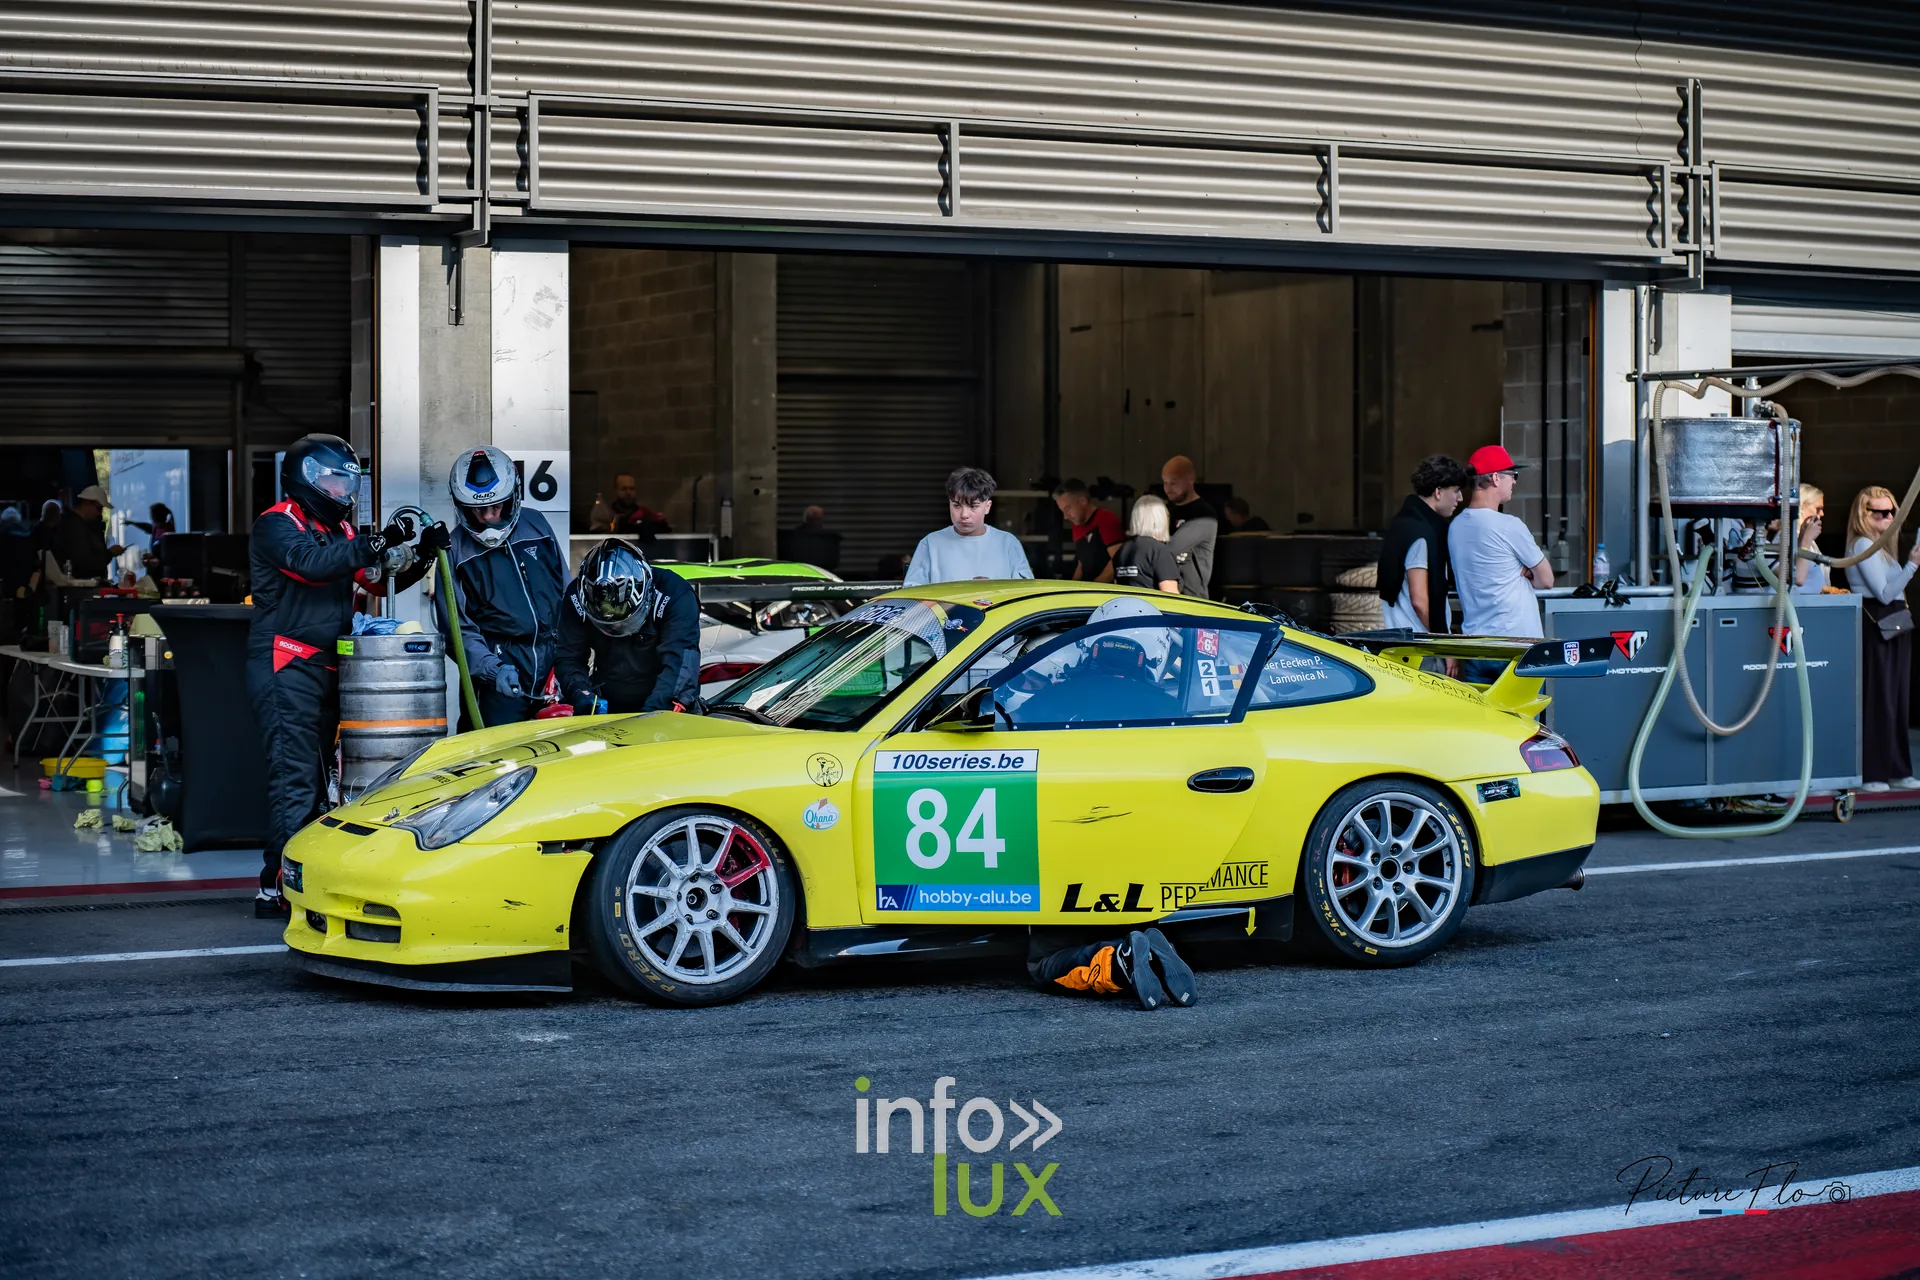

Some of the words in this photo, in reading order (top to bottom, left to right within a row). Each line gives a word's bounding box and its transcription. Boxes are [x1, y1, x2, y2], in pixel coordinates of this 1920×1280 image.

[514, 460, 558, 502] 16
[656, 595, 671, 618] sparco
[279, 640, 303, 653] sparco
[1201, 662, 1213, 675] 2
[1280, 657, 1314, 669] Eecken
[1314, 655, 1323, 665] P.
[1270, 672, 1316, 684] Lamonica
[1317, 670, 1328, 679] N.
[1364, 654, 1413, 678] PURE
[1418, 674, 1489, 705] CAPITAL
[892, 753, 1025, 770] 100series.be
[805, 809, 834, 824] Ohana
[905, 788, 1006, 870] 84
[919, 890, 1032, 907] hobby-alu.be
[1059, 883, 1154, 912] L&L
